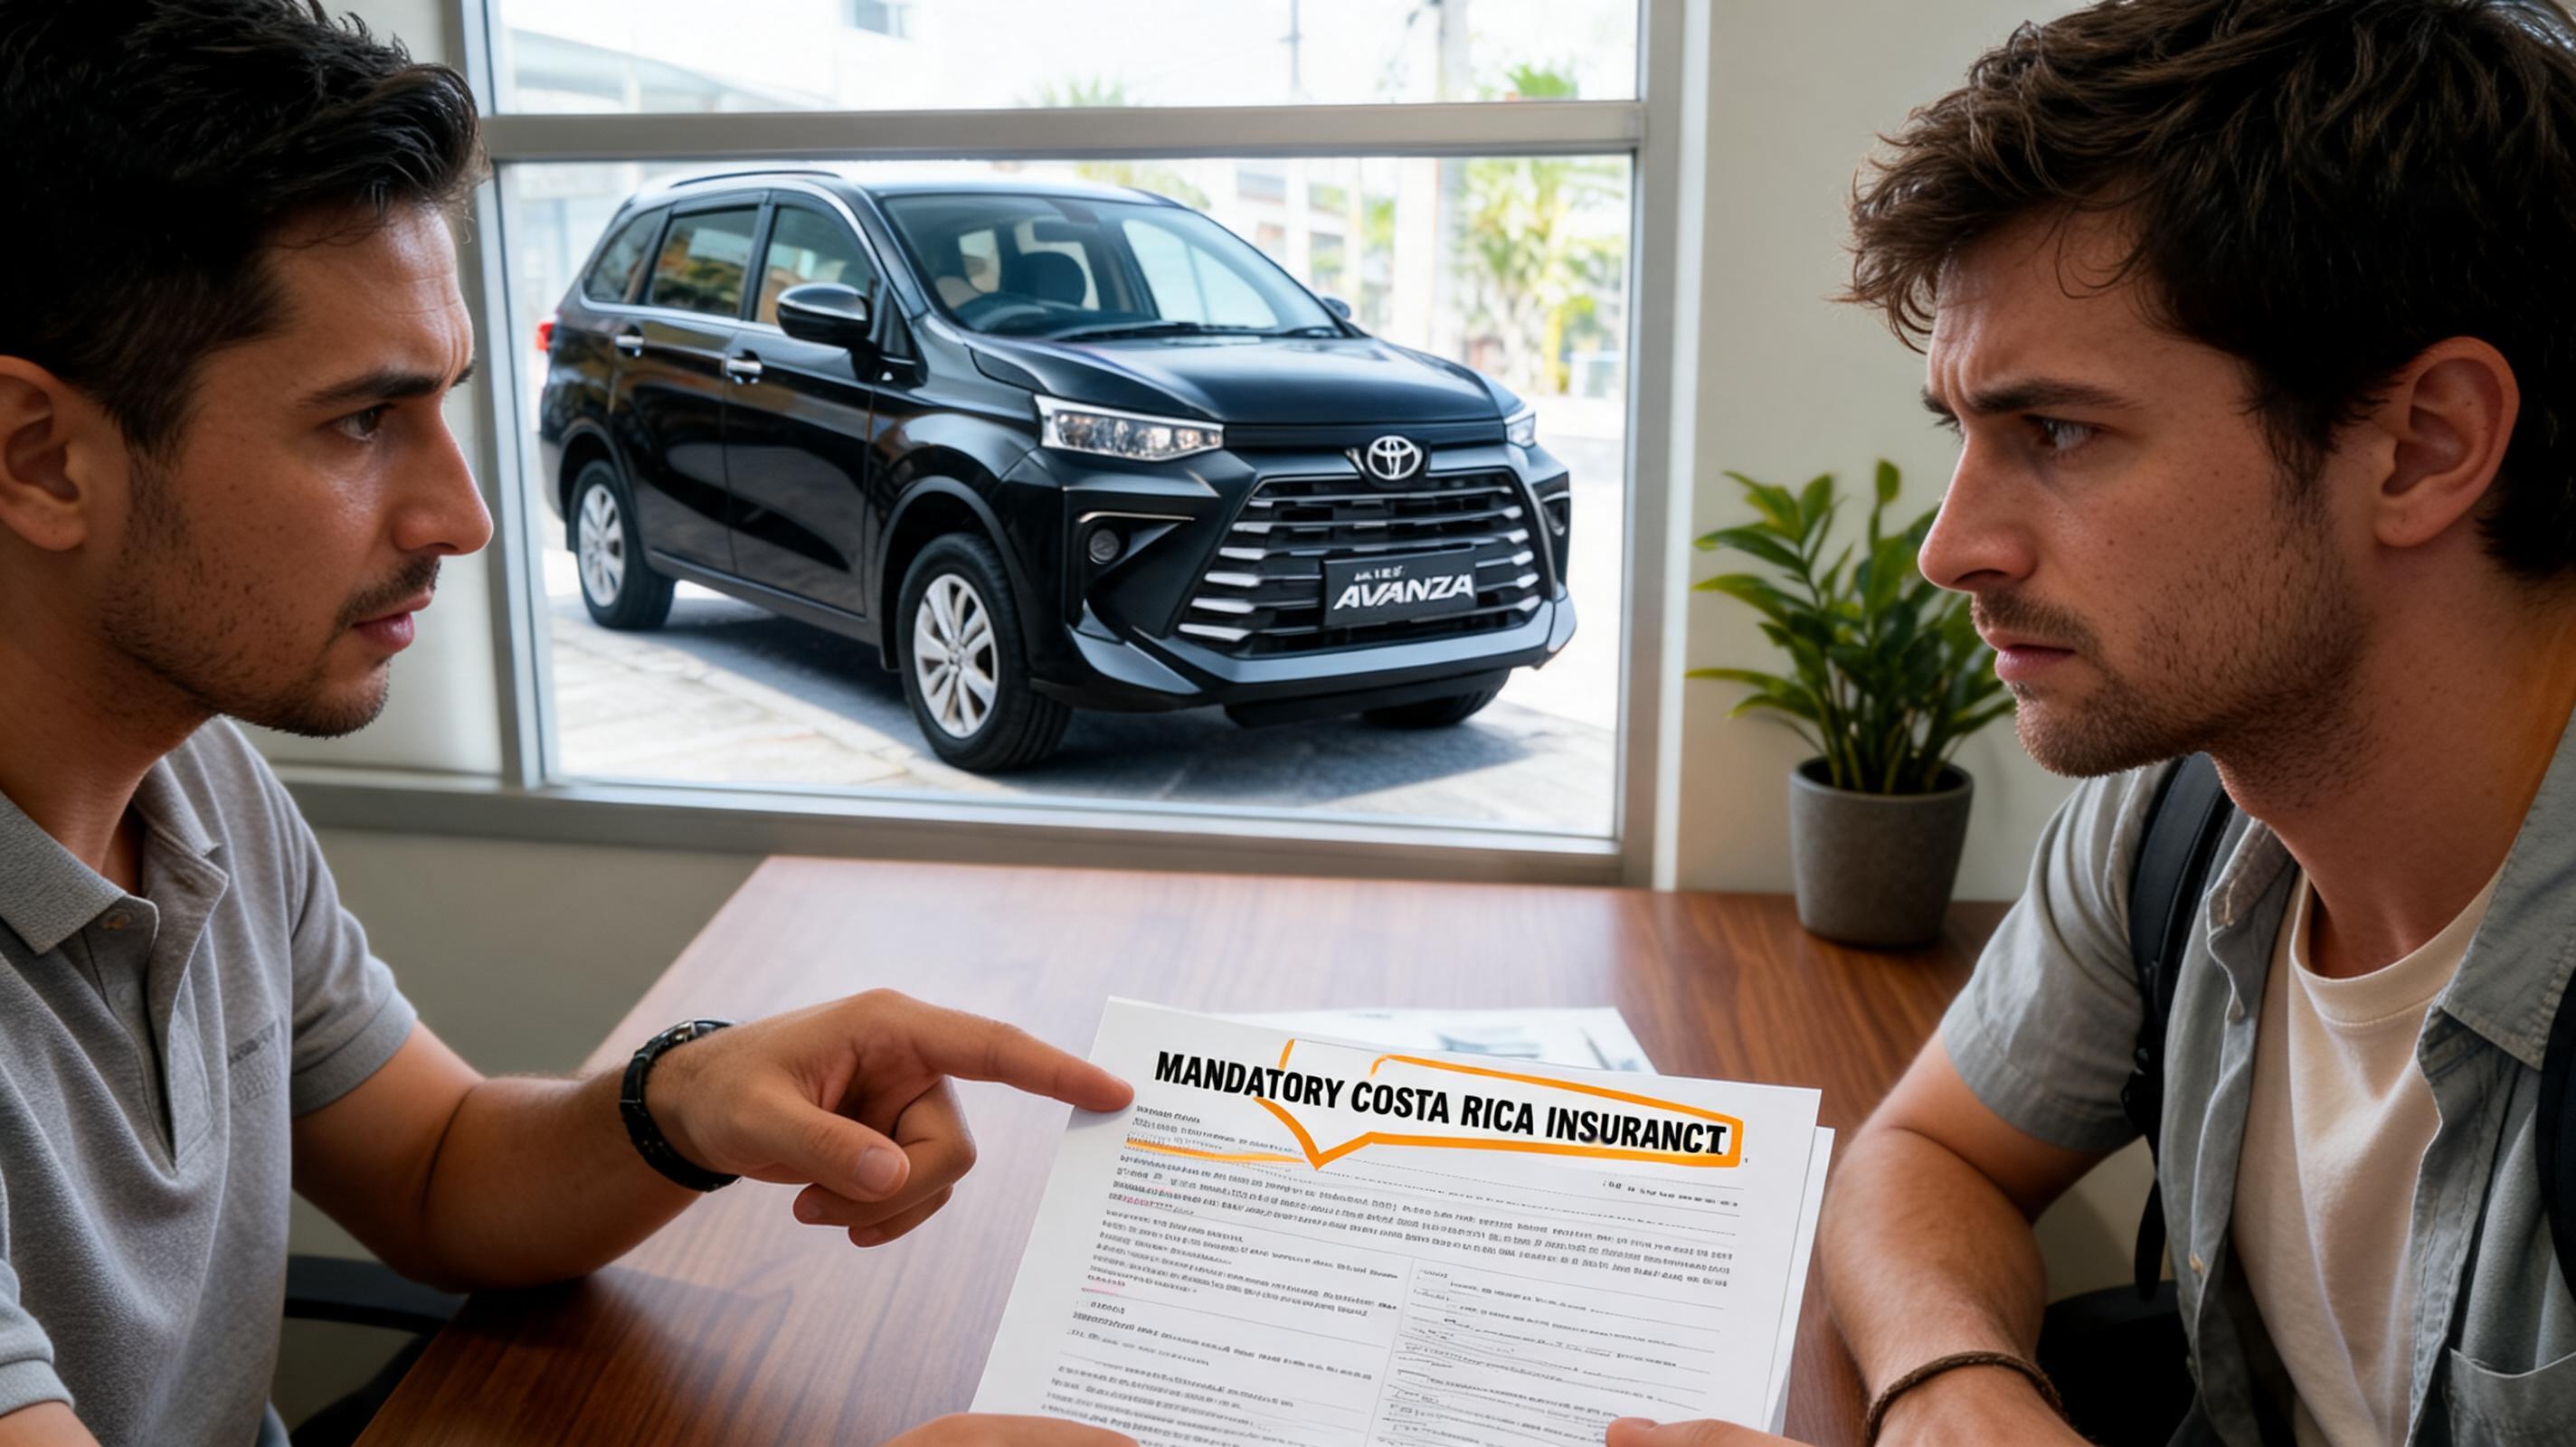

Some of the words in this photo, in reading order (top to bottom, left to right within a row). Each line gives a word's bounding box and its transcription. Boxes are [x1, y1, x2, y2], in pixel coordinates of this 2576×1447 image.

[1333, 573, 1474, 610] AVANZA
[1155, 1051, 1345, 1109] MANDATORY
[1350, 1081, 1450, 1124] COSTA
[1460, 1094, 1534, 1136] RICA
